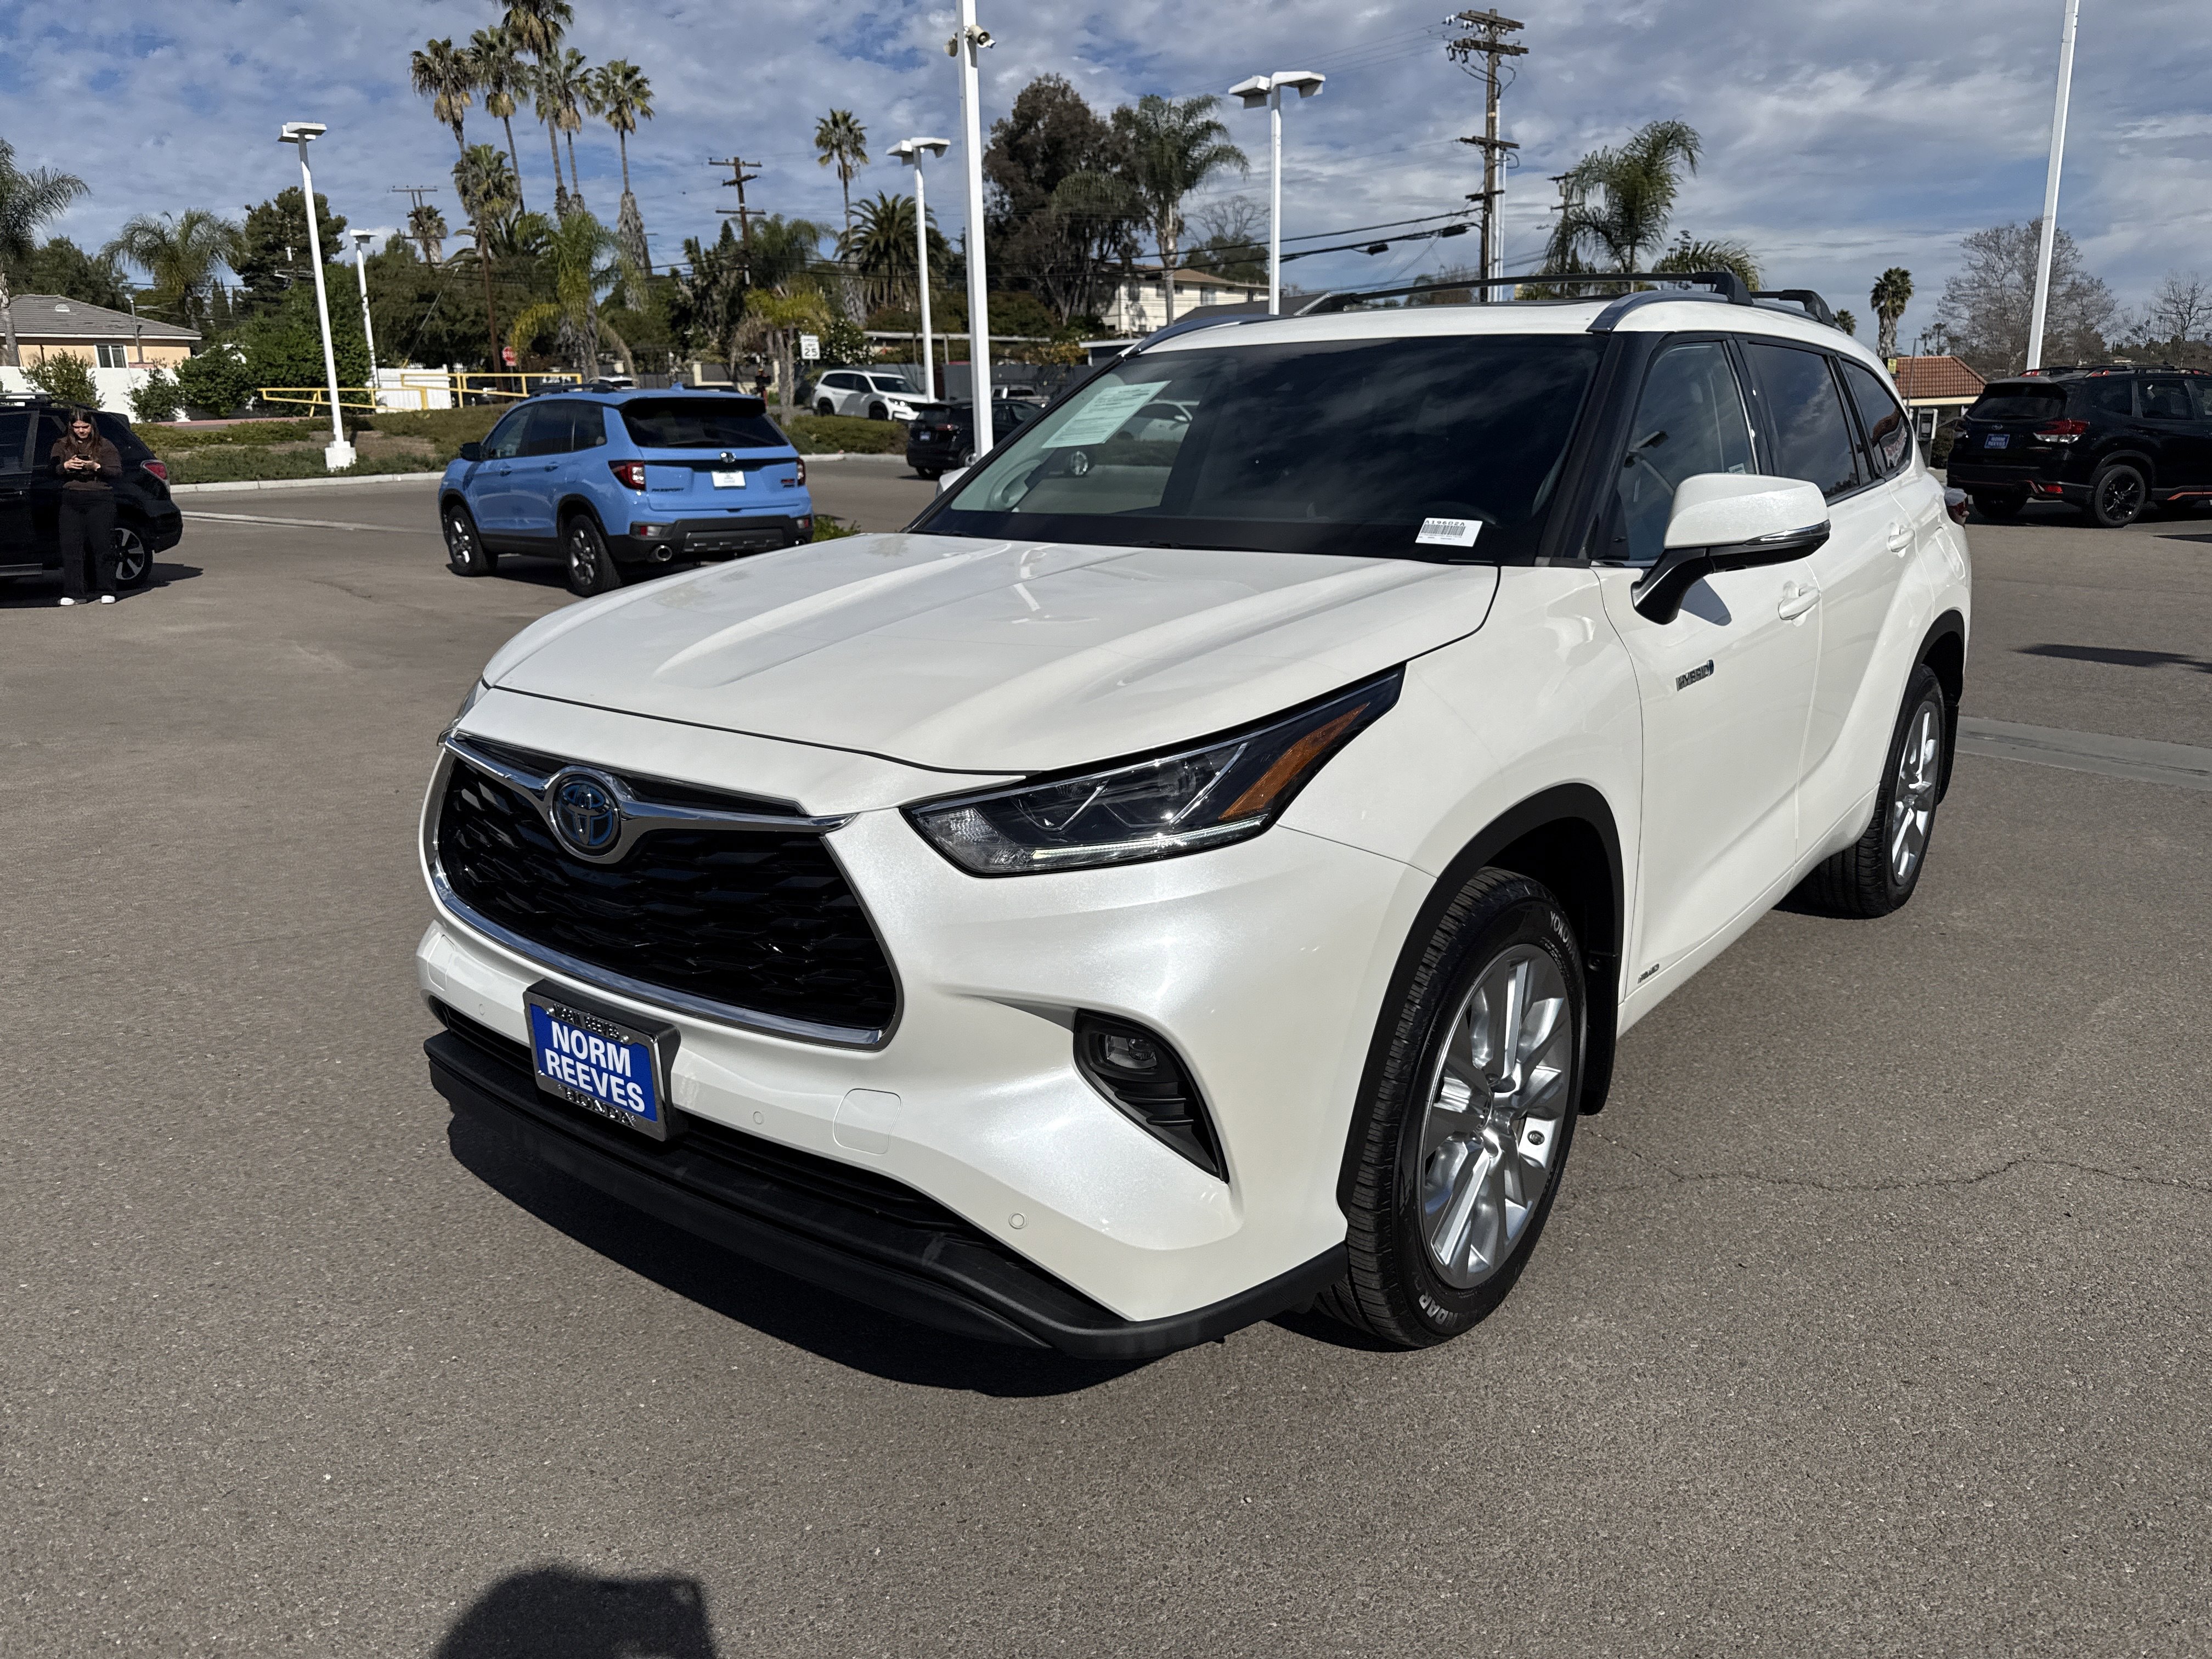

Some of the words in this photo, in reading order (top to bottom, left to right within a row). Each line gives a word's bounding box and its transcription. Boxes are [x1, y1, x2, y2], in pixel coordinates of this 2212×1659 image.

[805, 348, 818, 357] 25
[551, 1021, 631, 1077] NORM
[545, 1048, 645, 1112] REEVES
[563, 1086, 635, 1127] HONDA
